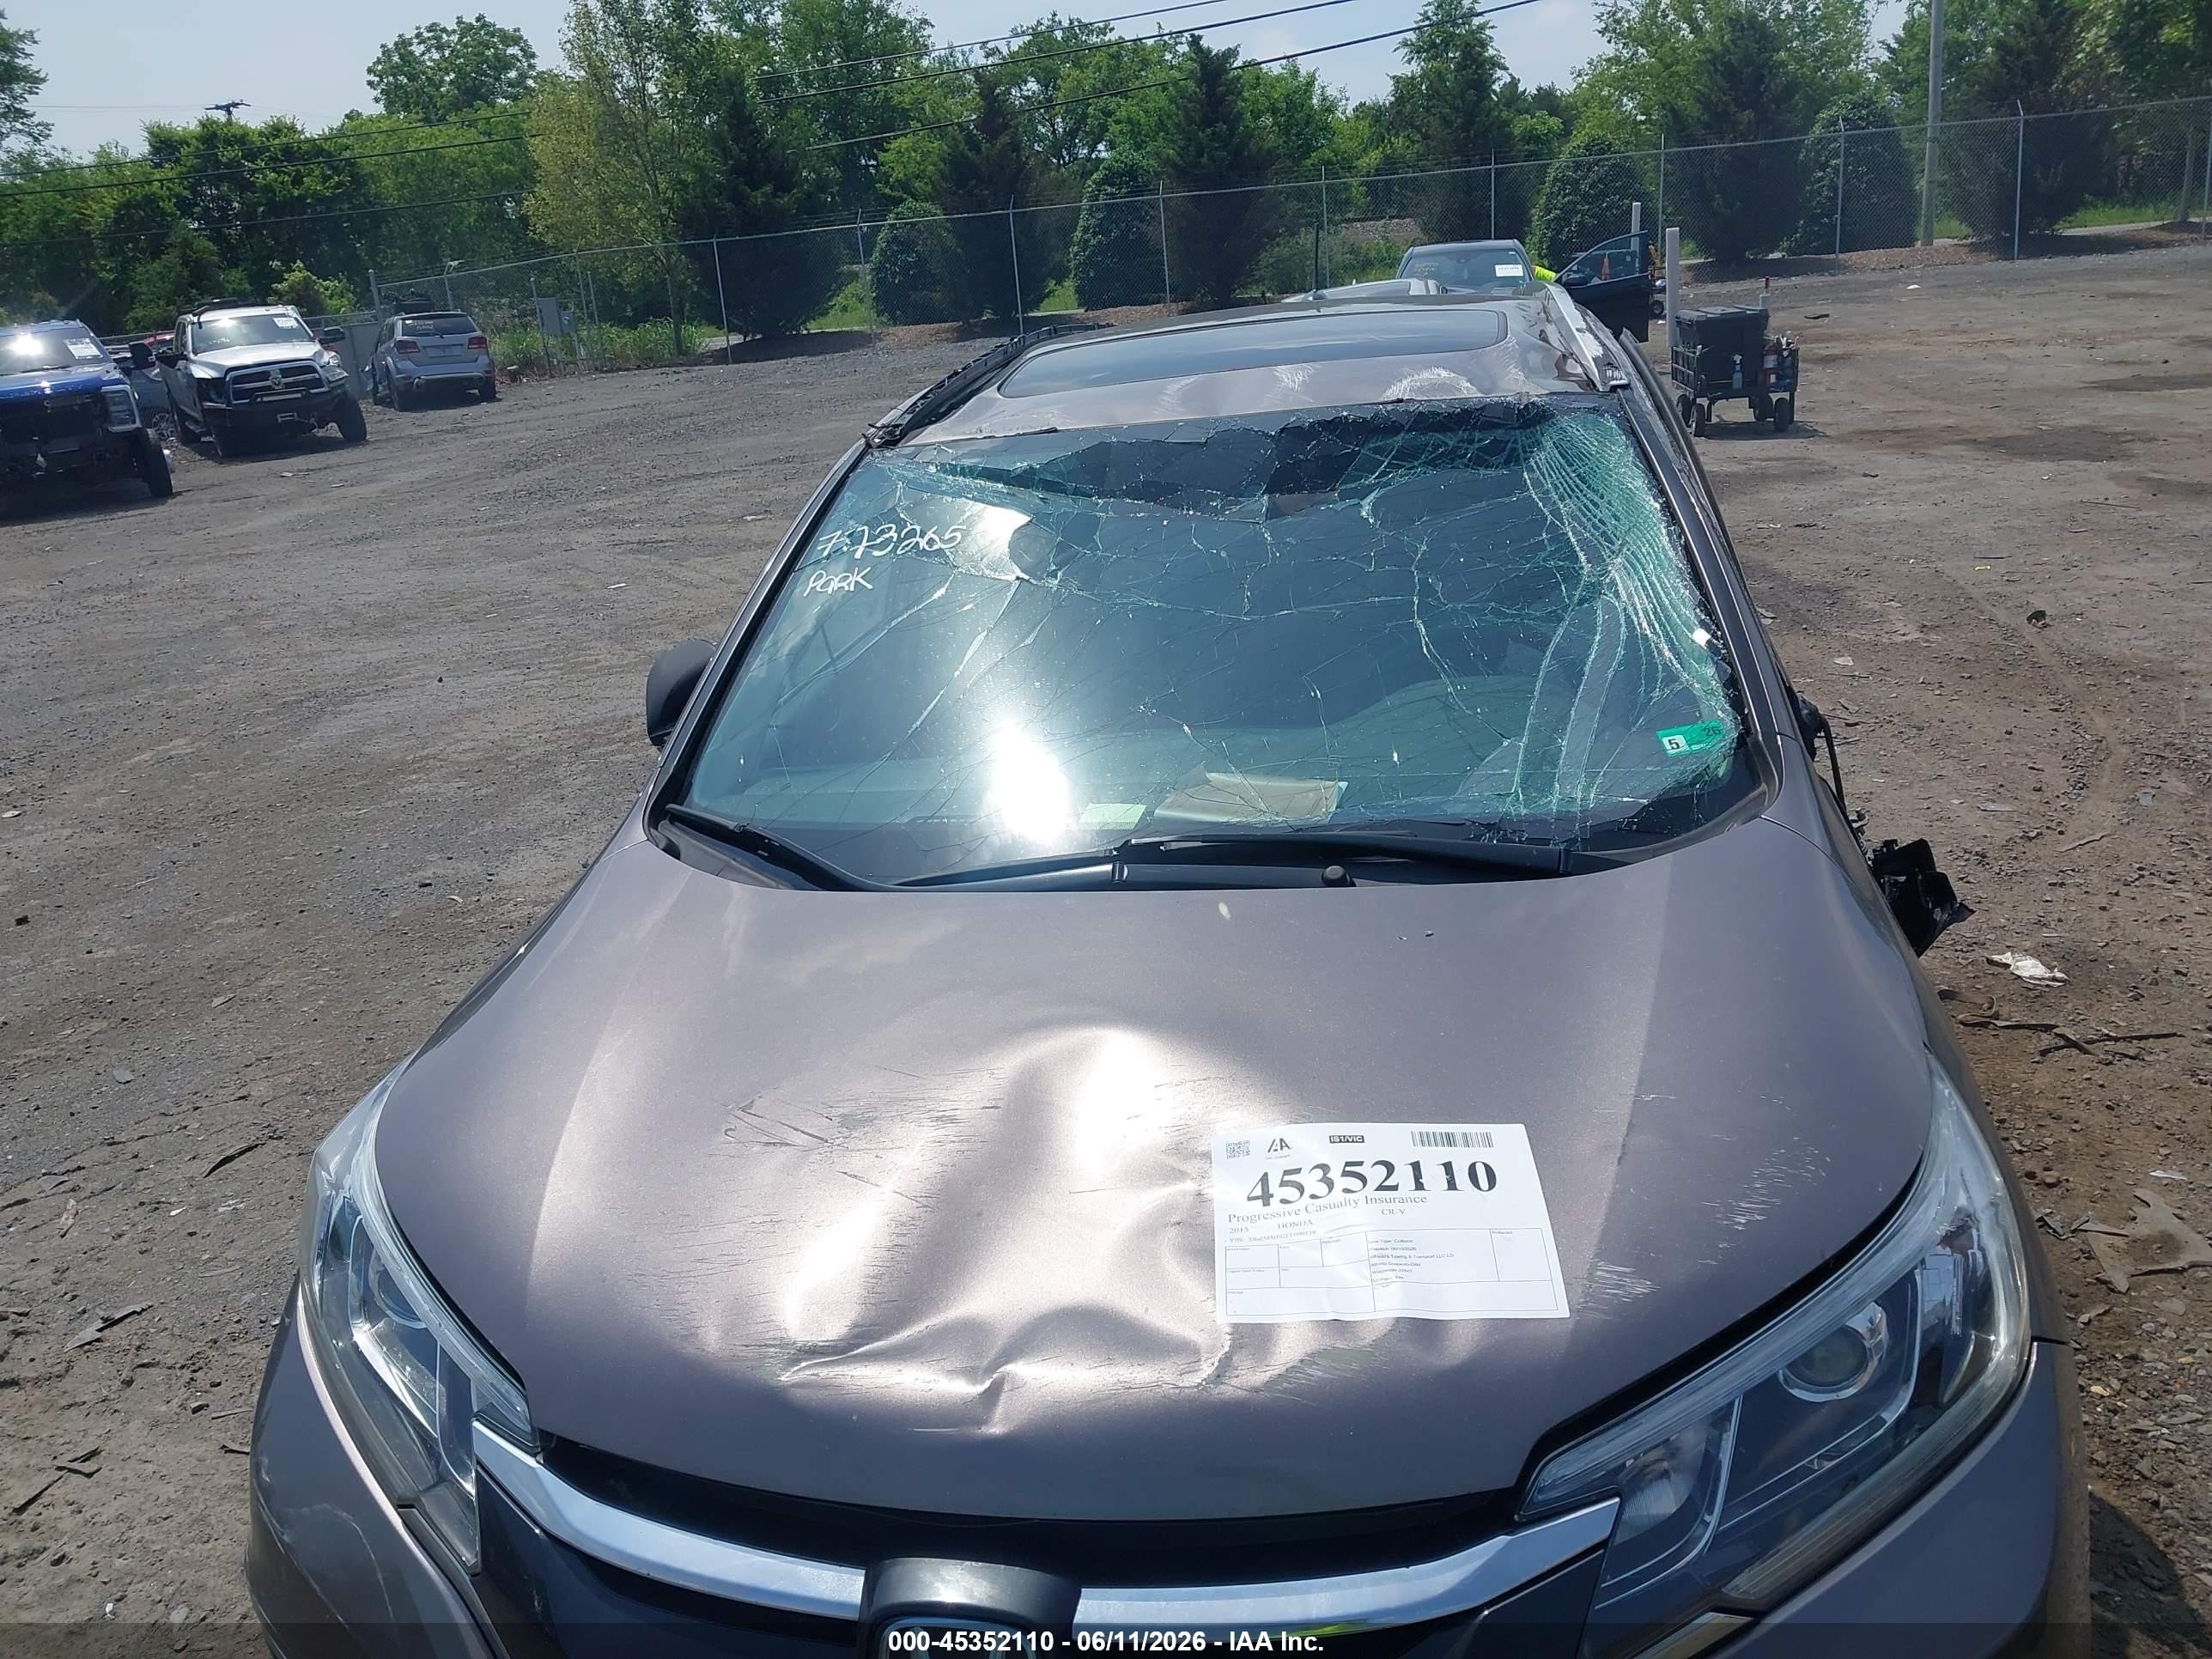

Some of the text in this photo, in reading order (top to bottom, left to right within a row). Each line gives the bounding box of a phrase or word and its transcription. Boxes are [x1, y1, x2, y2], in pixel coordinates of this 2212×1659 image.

[1668, 738, 1680, 750] 5
[1247, 1159, 1497, 1206] 45352110
[1228, 1194, 1428, 1224] Progressive Casualty Insurance
[1278, 1219, 1314, 1230] HONDA
